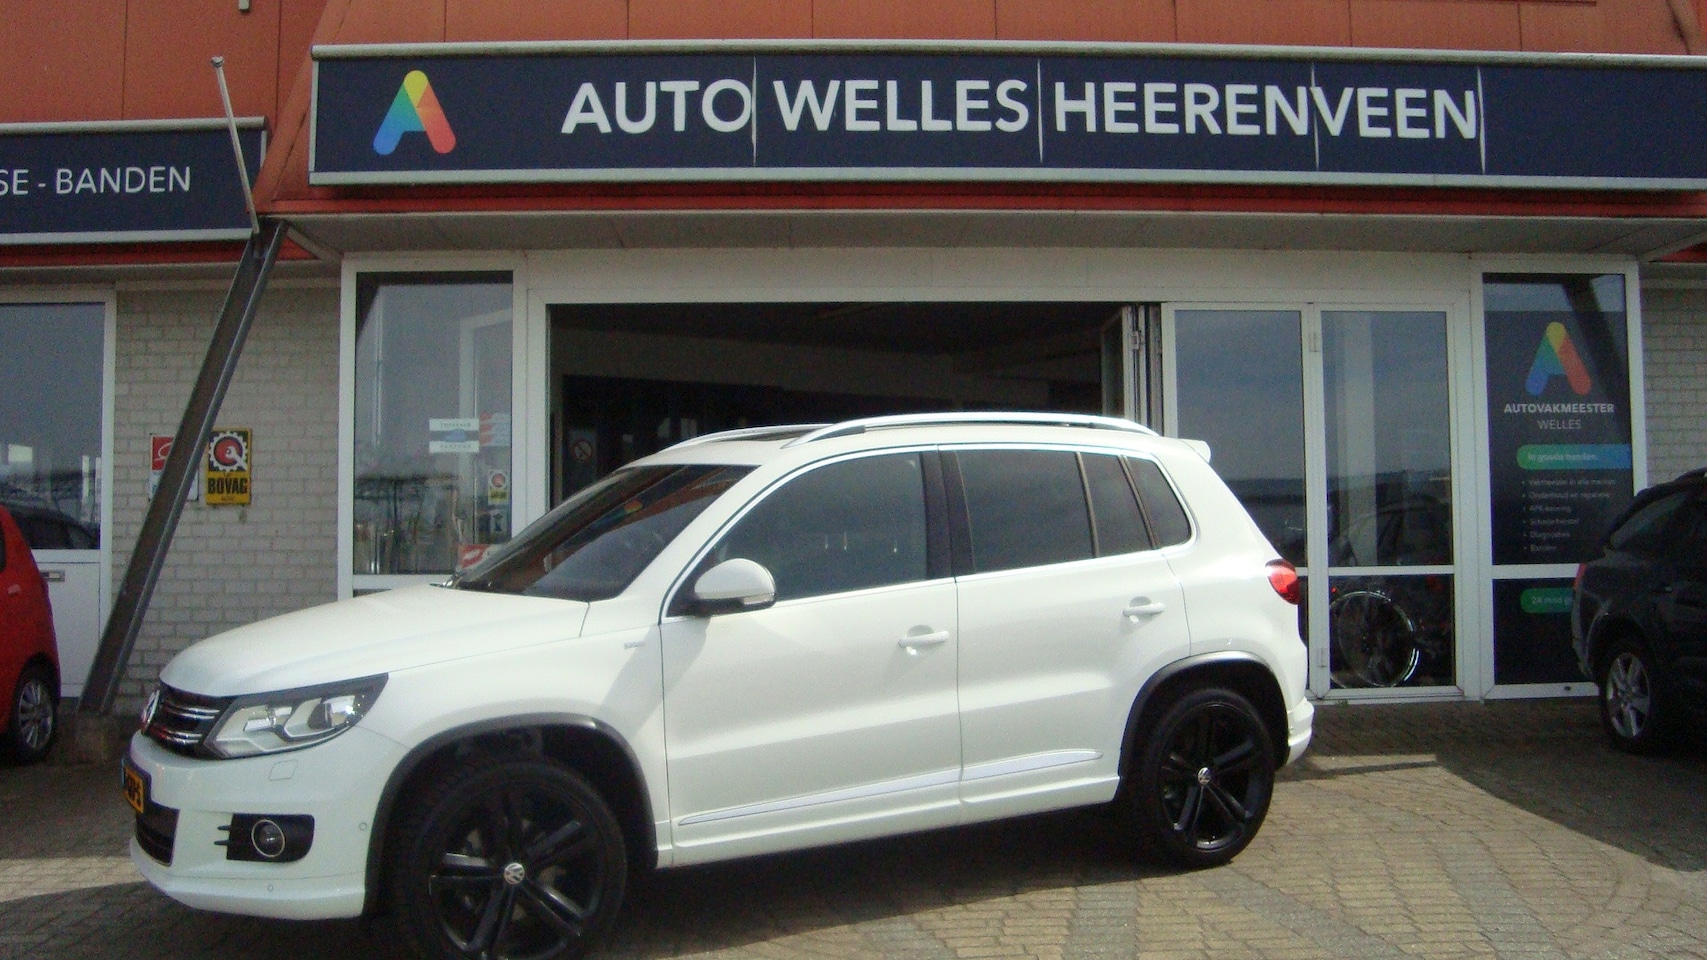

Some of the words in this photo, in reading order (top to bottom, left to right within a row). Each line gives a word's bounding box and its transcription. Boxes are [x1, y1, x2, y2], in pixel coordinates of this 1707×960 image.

[561, 79, 753, 134] AUTO
[773, 79, 1029, 133] WELLES
[1055, 81, 1477, 139] HEERENVEEN
[56, 166, 191, 194] BANDEN
[1504, 403, 1615, 413] AUTOVAKMEESTER
[1537, 419, 1582, 430] WELLES
[207, 477, 248, 494] BOVAG
